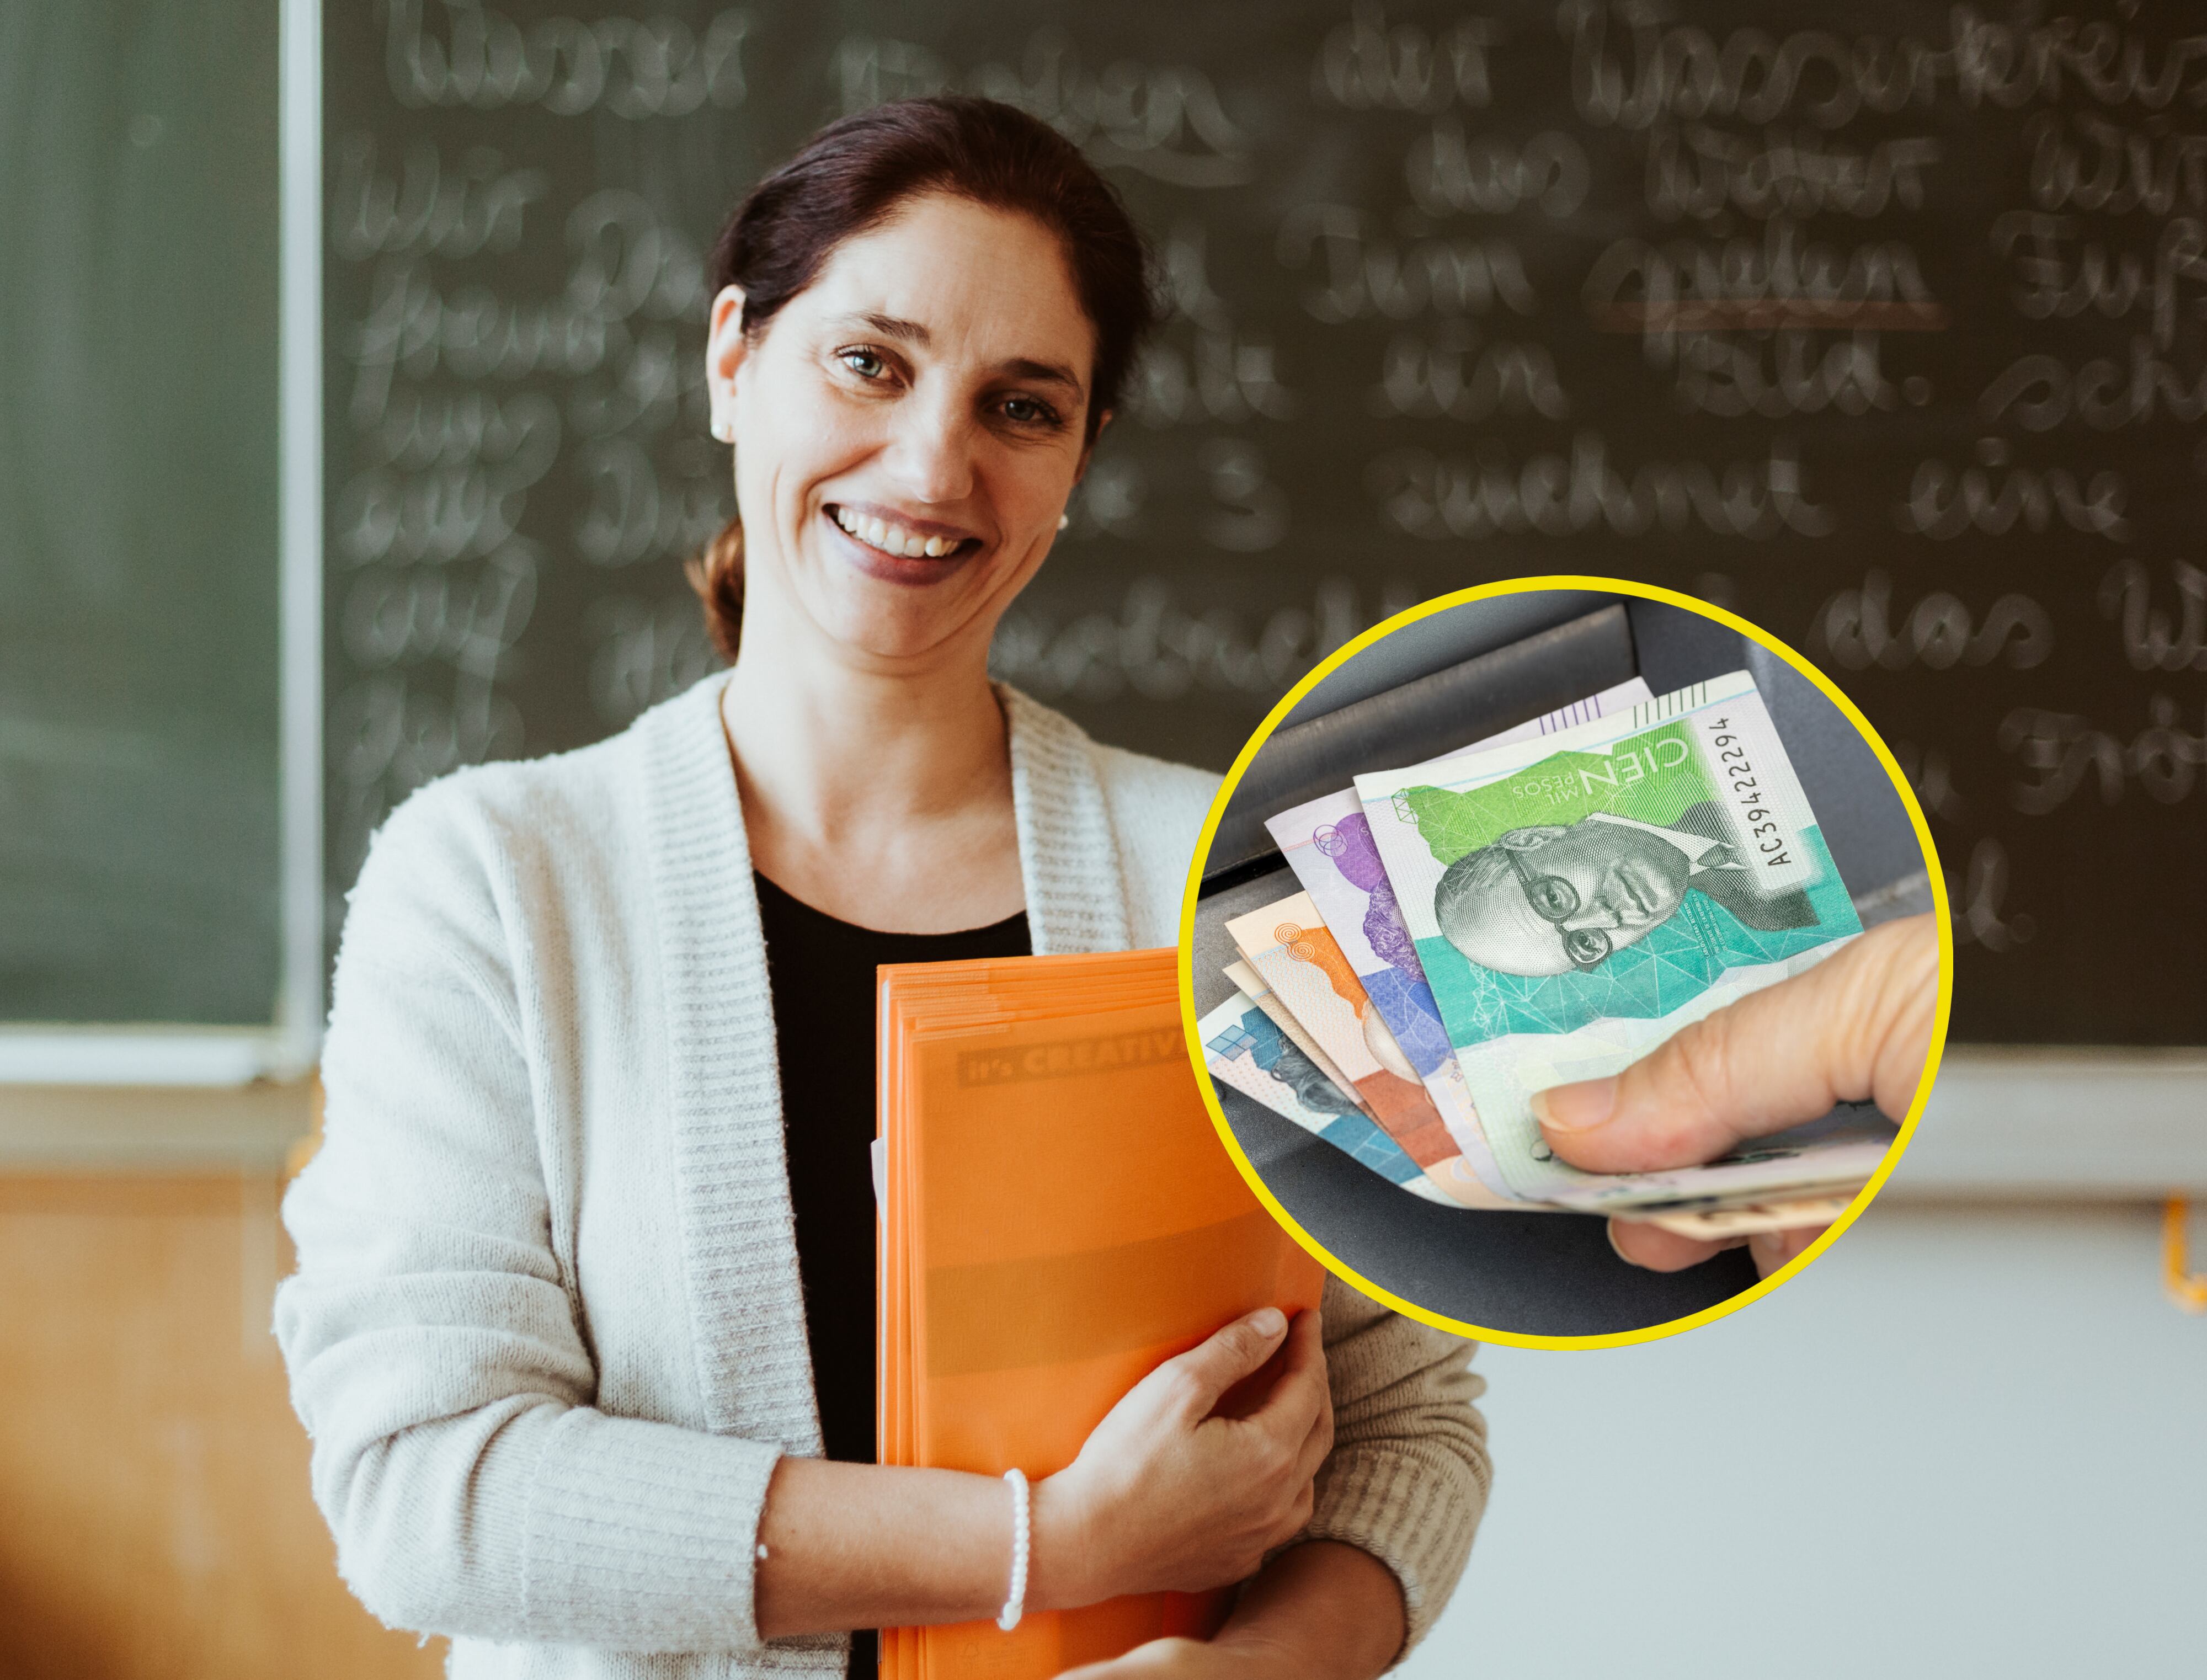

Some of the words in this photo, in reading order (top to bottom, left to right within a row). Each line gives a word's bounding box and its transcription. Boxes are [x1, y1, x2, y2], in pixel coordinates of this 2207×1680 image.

[1579, 738, 1689, 795] CIEN
[1512, 775, 1575, 799] PESOS
[1545, 785, 1579, 807] MIL
[1709, 718, 1792, 866] AC39422294
[1683, 902, 1696, 924] RESTREPO
[1692, 924, 1703, 941] LLERAS
[1707, 929, 1720, 953] PRESIDENTE
[1712, 922, 1725, 945] COLOMBIA
[1022, 1031, 1185, 1074] CREATIV
